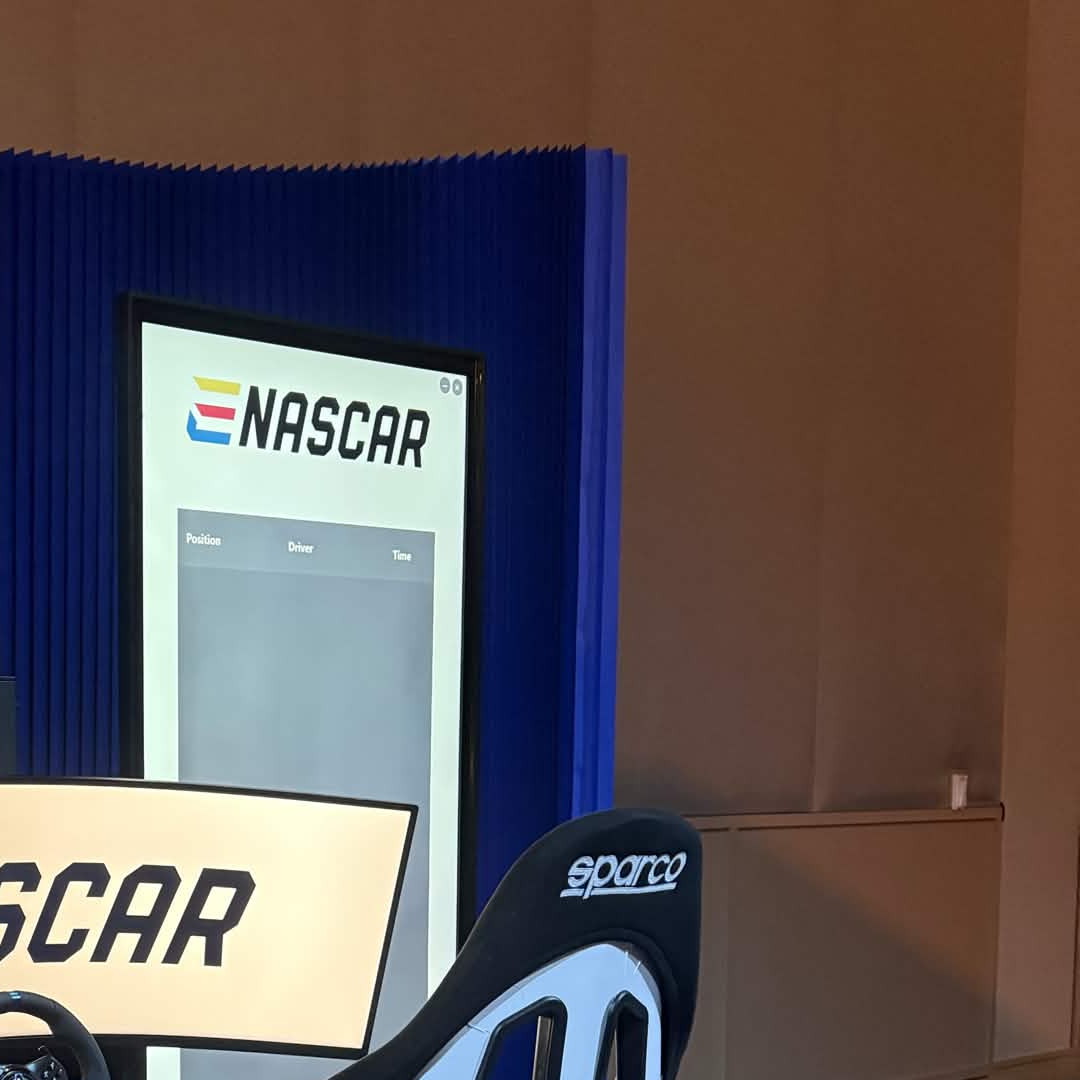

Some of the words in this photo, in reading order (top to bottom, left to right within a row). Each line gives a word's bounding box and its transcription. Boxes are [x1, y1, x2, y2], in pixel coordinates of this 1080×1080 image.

[185, 532, 221, 546] Position
[288, 541, 314, 554] Driver
[392, 550, 412, 562] Time
[567, 851, 688, 900] sparco
